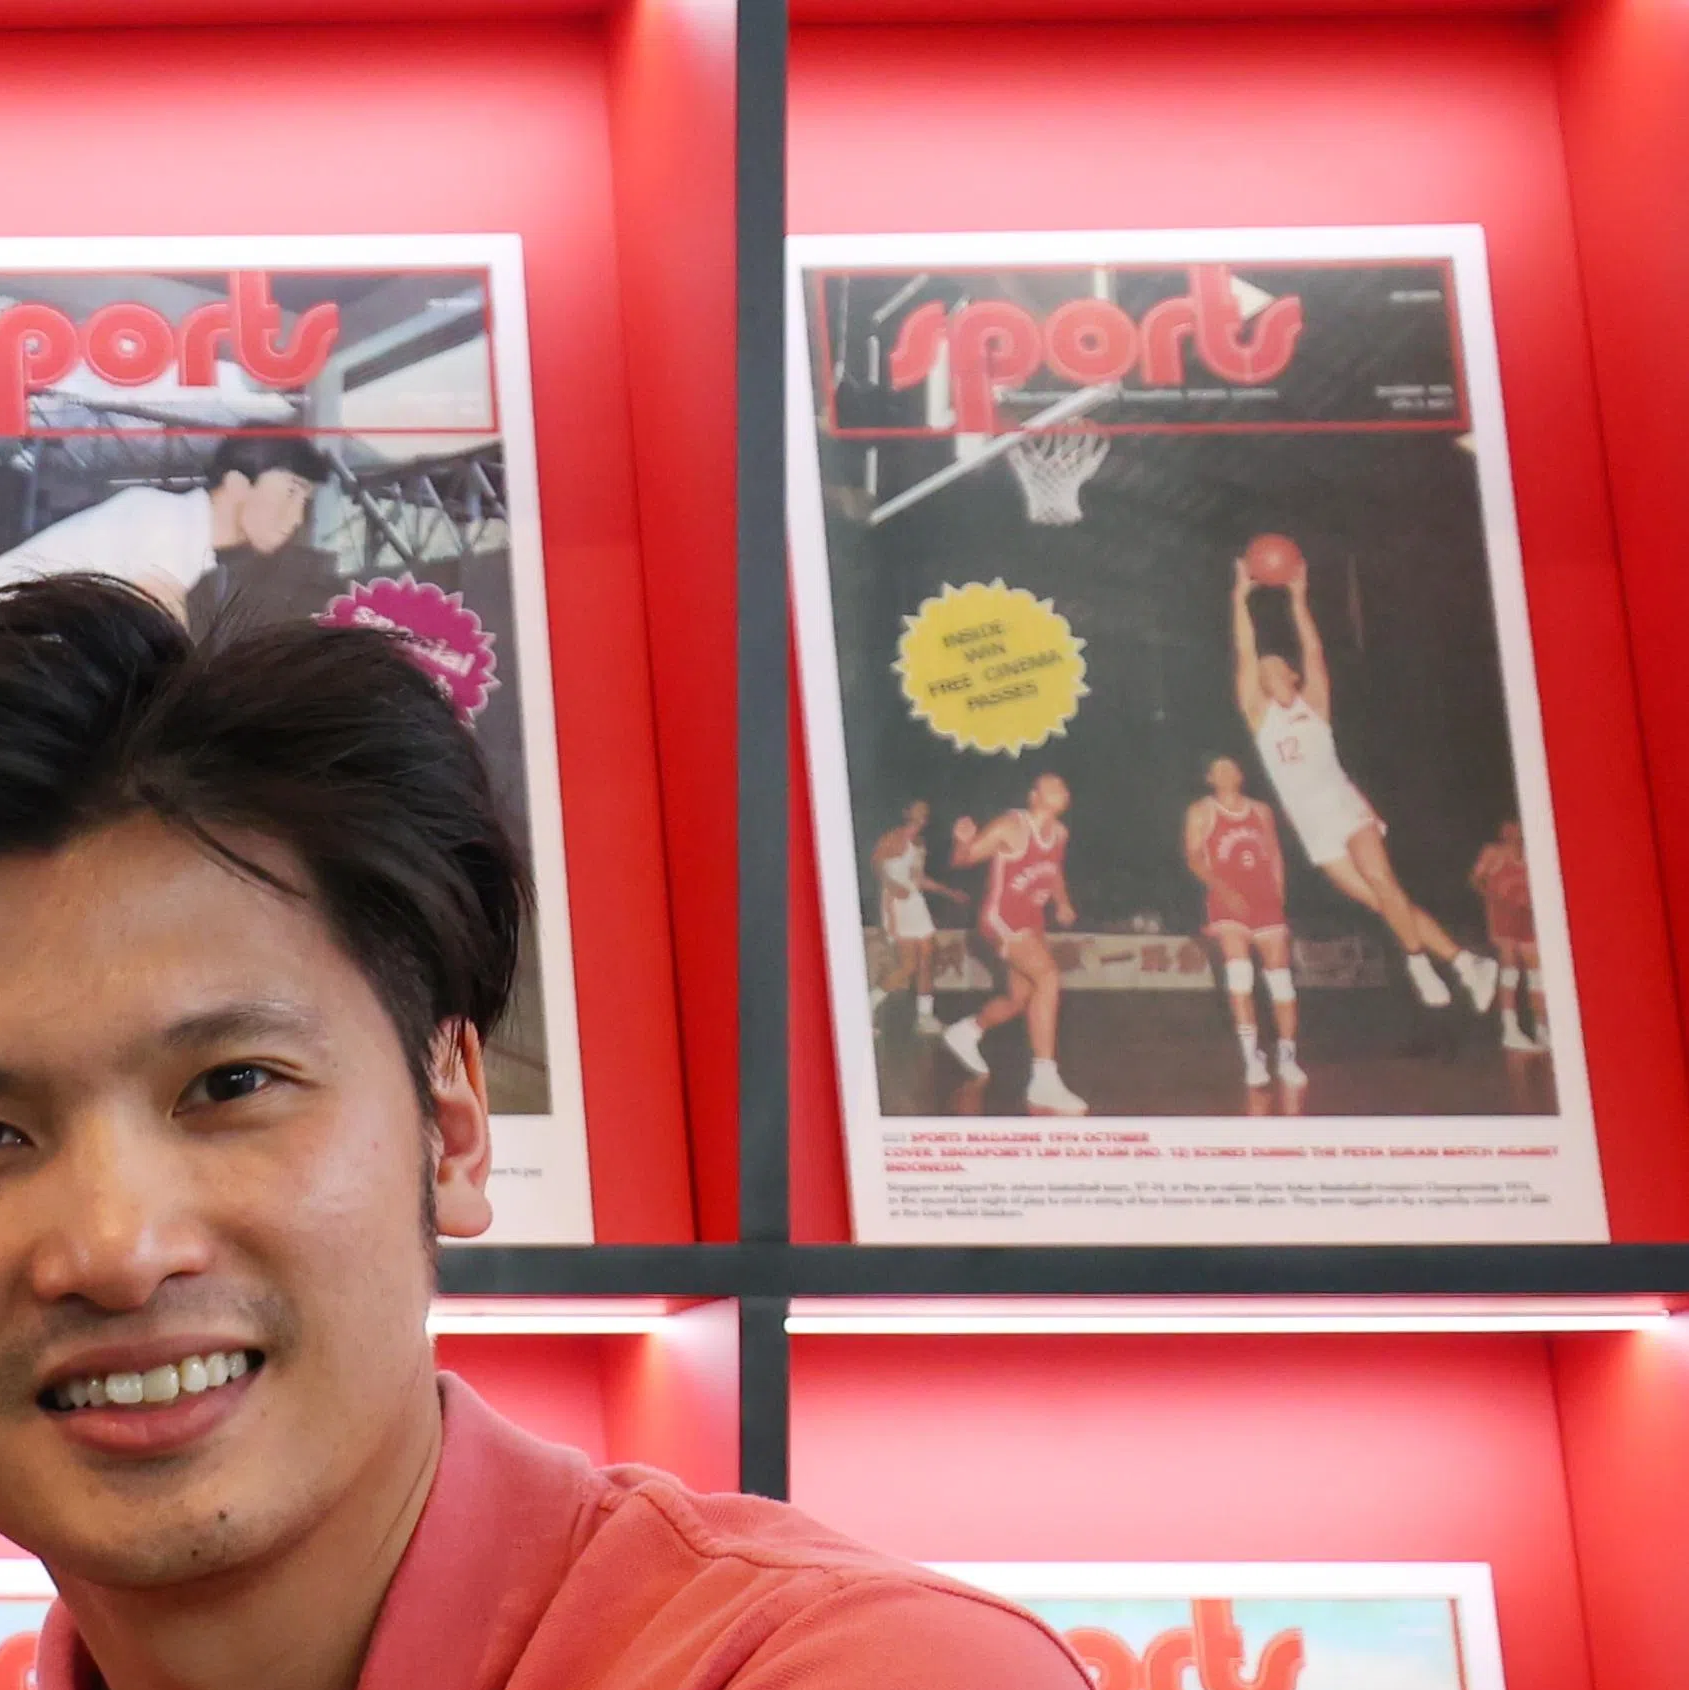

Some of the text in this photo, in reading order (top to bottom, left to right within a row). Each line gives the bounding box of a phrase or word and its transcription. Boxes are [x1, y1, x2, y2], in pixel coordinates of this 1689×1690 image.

[889, 262, 1302, 433] sports
[927, 649, 1063, 698] FREE CINEMA
